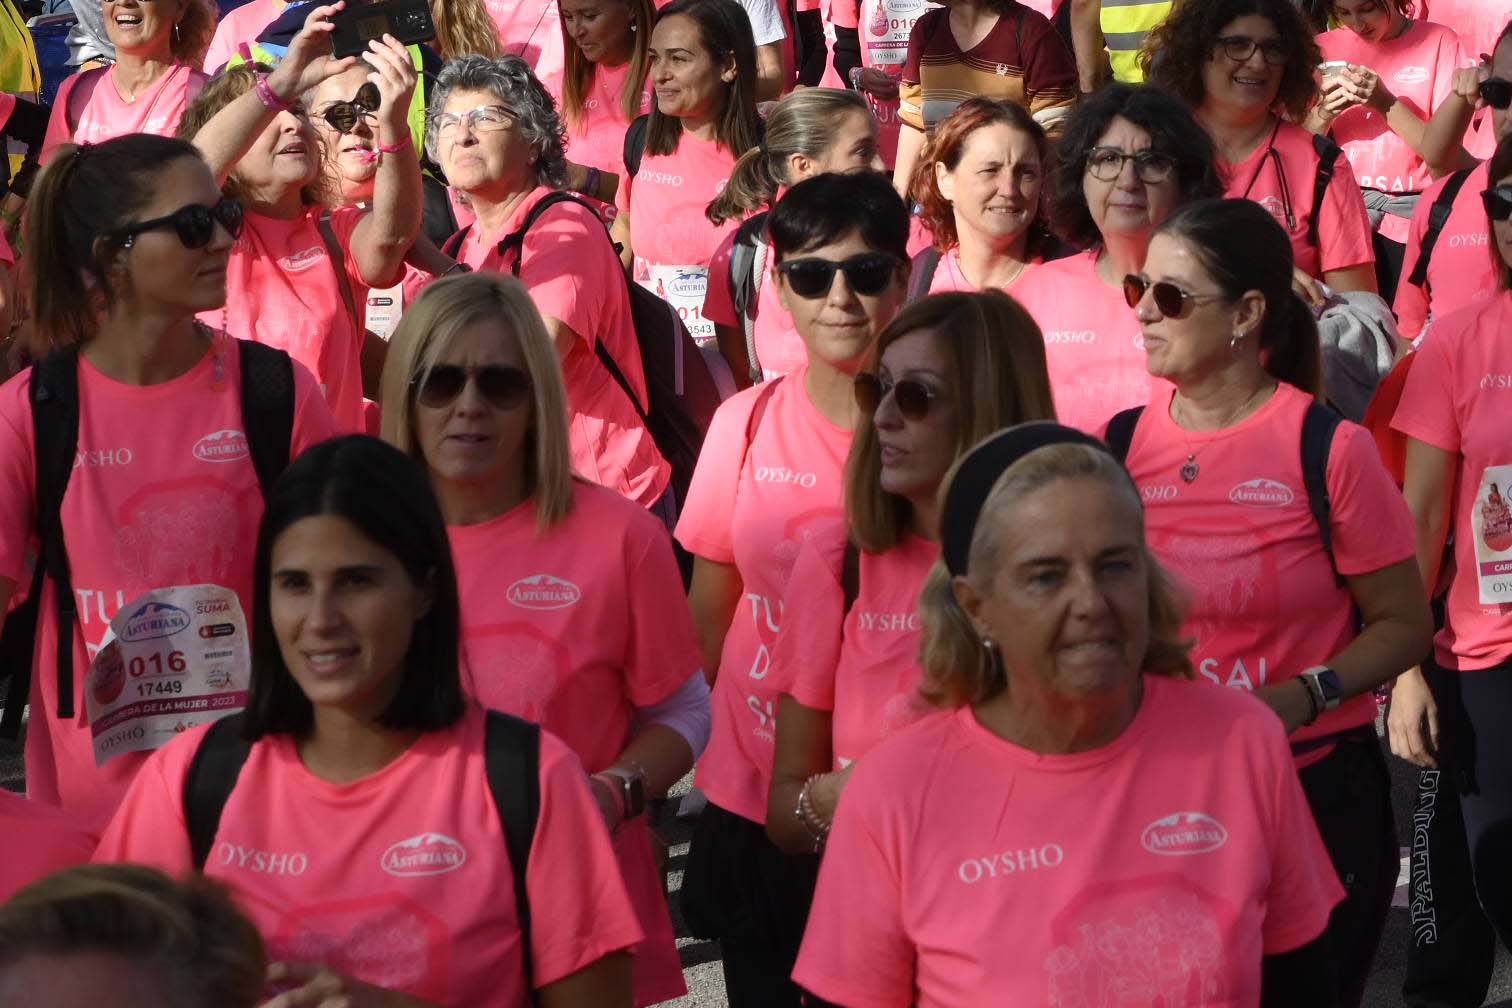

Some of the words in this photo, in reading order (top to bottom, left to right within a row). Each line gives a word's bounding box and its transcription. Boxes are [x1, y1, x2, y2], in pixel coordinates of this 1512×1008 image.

[640, 168, 683, 187] OYSHO
[754, 466, 817, 489] OYSHO
[1232, 488, 1289, 503] ASTURIANA
[513, 586, 576, 601] ASTURIANA
[196, 603, 231, 615] SUMA
[126, 618, 186, 637] ASTURIANA
[129, 650, 187, 678] 016
[137, 680, 183, 697] 17449
[143, 703, 159, 713] DE
[159, 702, 173, 711] LA
[174, 698, 210, 709] MUJER
[211, 695, 236, 706] 2023
[217, 841, 309, 876] OYSHO
[388, 850, 462, 869] ASTURIANA
[958, 843, 1065, 886] OYSHO
[1147, 826, 1221, 849] ASTURIANA
